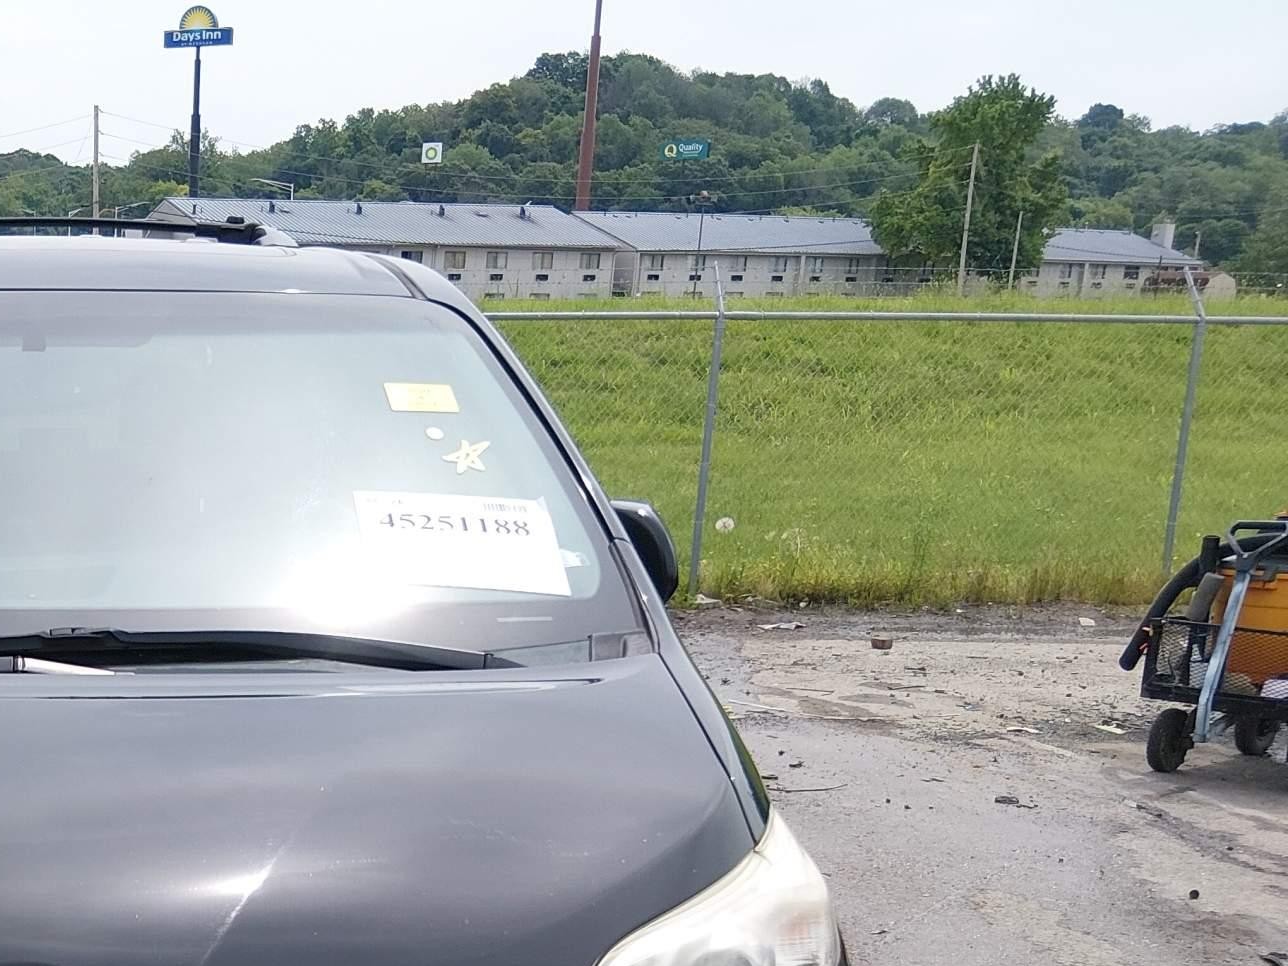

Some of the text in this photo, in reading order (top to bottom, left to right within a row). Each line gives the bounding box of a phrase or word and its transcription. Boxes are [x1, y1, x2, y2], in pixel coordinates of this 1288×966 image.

[172, 30, 222, 42] Days Inn
[678, 143, 704, 153] Quality
[379, 512, 531, 537] 45251188
